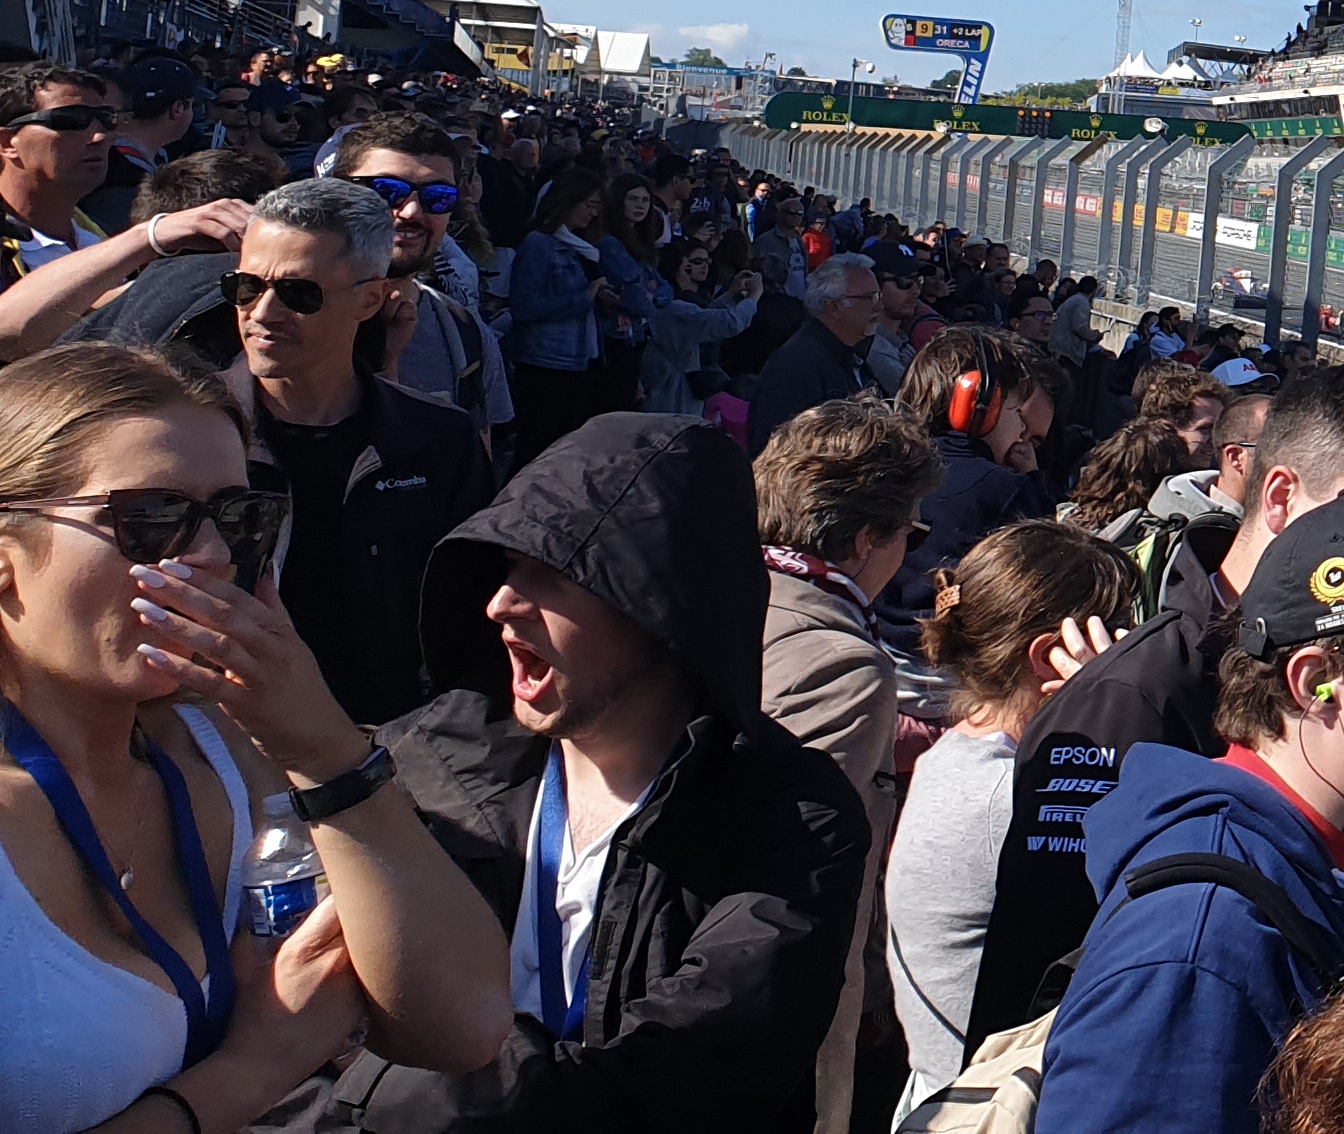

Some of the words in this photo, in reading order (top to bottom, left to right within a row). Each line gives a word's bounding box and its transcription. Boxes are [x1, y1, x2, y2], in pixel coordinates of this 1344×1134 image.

[921, 23, 928, 34] 9
[935, 25, 947, 34] 31
[936, 38, 970, 48] ORECA
[802, 110, 850, 122] ROLEX
[1050, 747, 1116, 767] EPSON
[1035, 778, 1119, 794] BOSE
